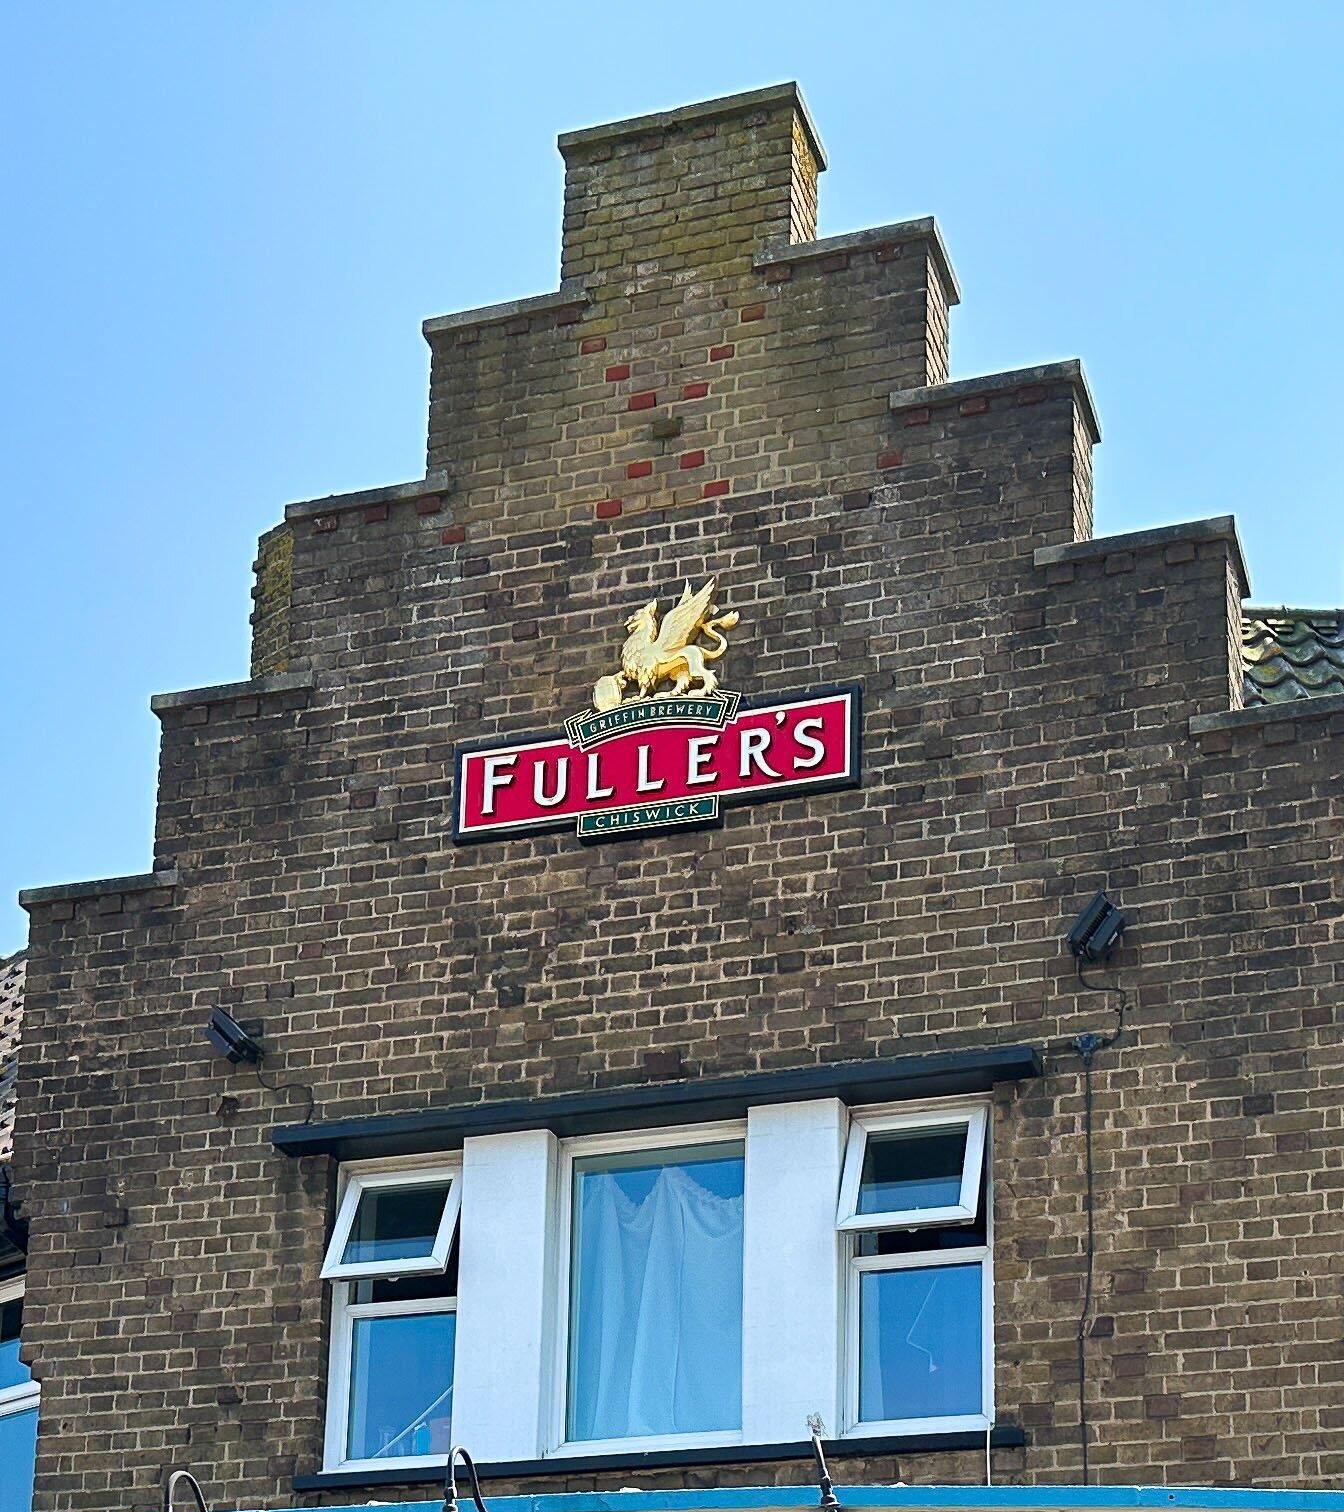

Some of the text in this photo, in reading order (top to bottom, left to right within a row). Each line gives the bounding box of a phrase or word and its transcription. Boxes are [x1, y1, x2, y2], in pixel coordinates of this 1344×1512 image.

[589, 703, 713, 733] GRIFFIN BREWERY
[480, 711, 826, 815] FULLER'S
[595, 802, 700, 828] CHISWICK
